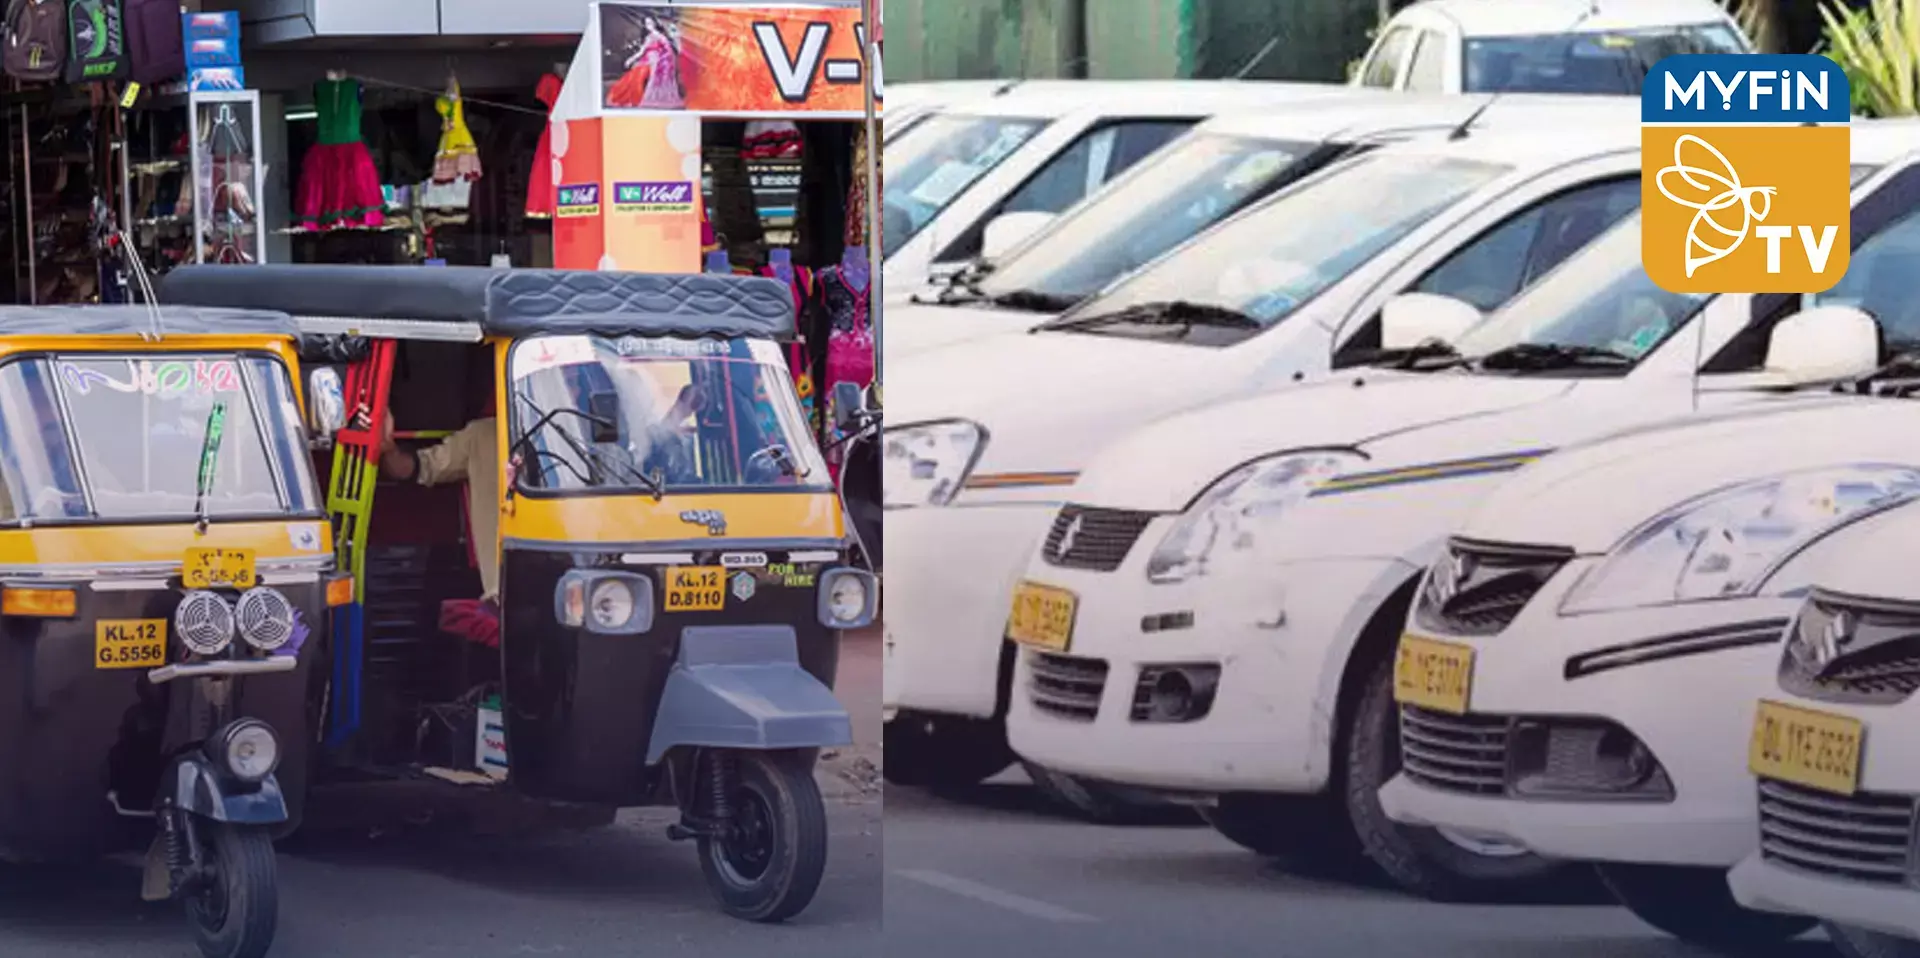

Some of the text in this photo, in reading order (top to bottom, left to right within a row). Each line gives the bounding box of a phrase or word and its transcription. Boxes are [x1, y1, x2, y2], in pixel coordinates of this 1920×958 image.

[674, 571, 718, 588] KL.12
[669, 590, 721, 606] D.8110
[105, 624, 157, 642] KL.12
[99, 644, 162, 663] G.5556
